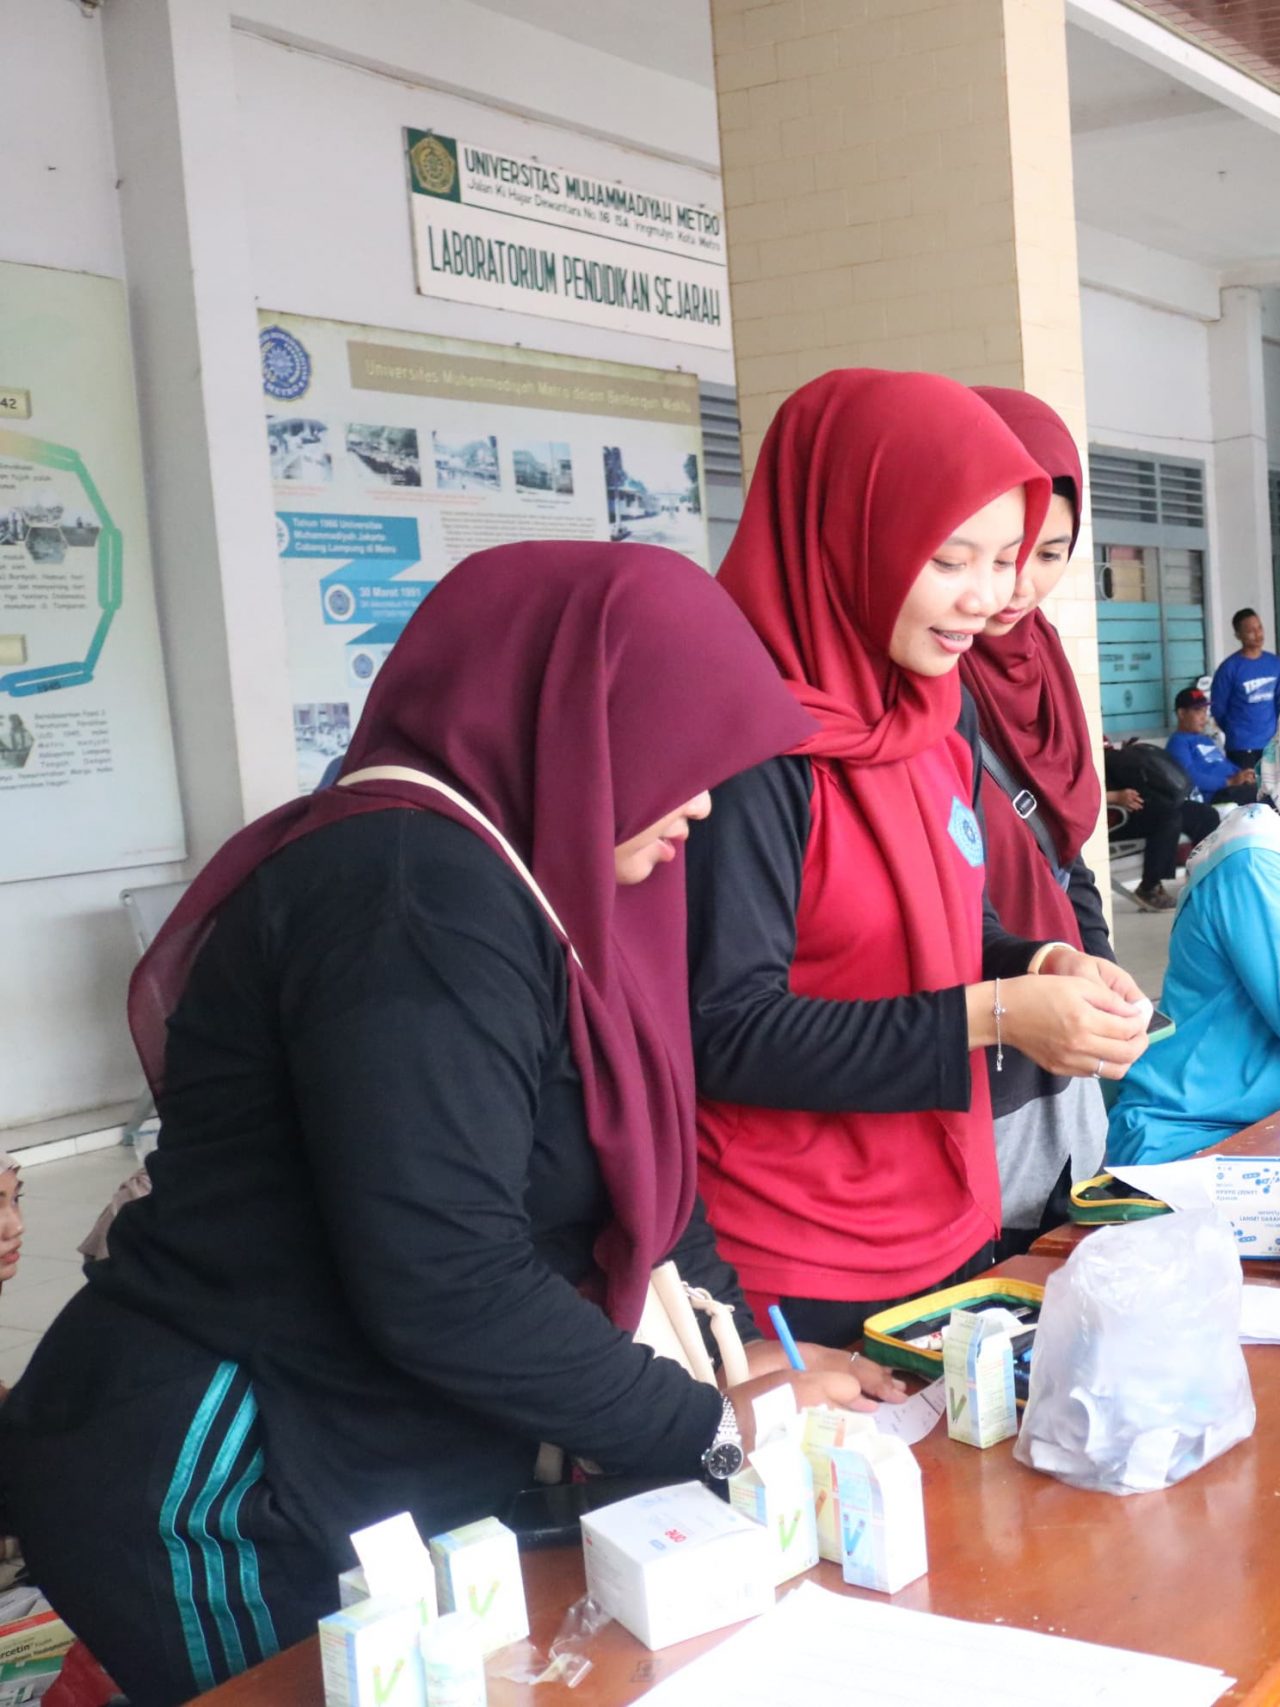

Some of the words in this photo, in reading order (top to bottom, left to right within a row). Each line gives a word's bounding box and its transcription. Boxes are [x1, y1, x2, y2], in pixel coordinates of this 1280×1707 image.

[464, 147, 561, 195] UNIVERSITAS
[565, 175, 673, 222] MUHAMMADIYAH
[677, 204, 721, 236] METRO
[427, 225, 558, 295] LABORATORIUM
[563, 254, 651, 313] PENDIDIKAN
[654, 275, 721, 327] SEJARAH
